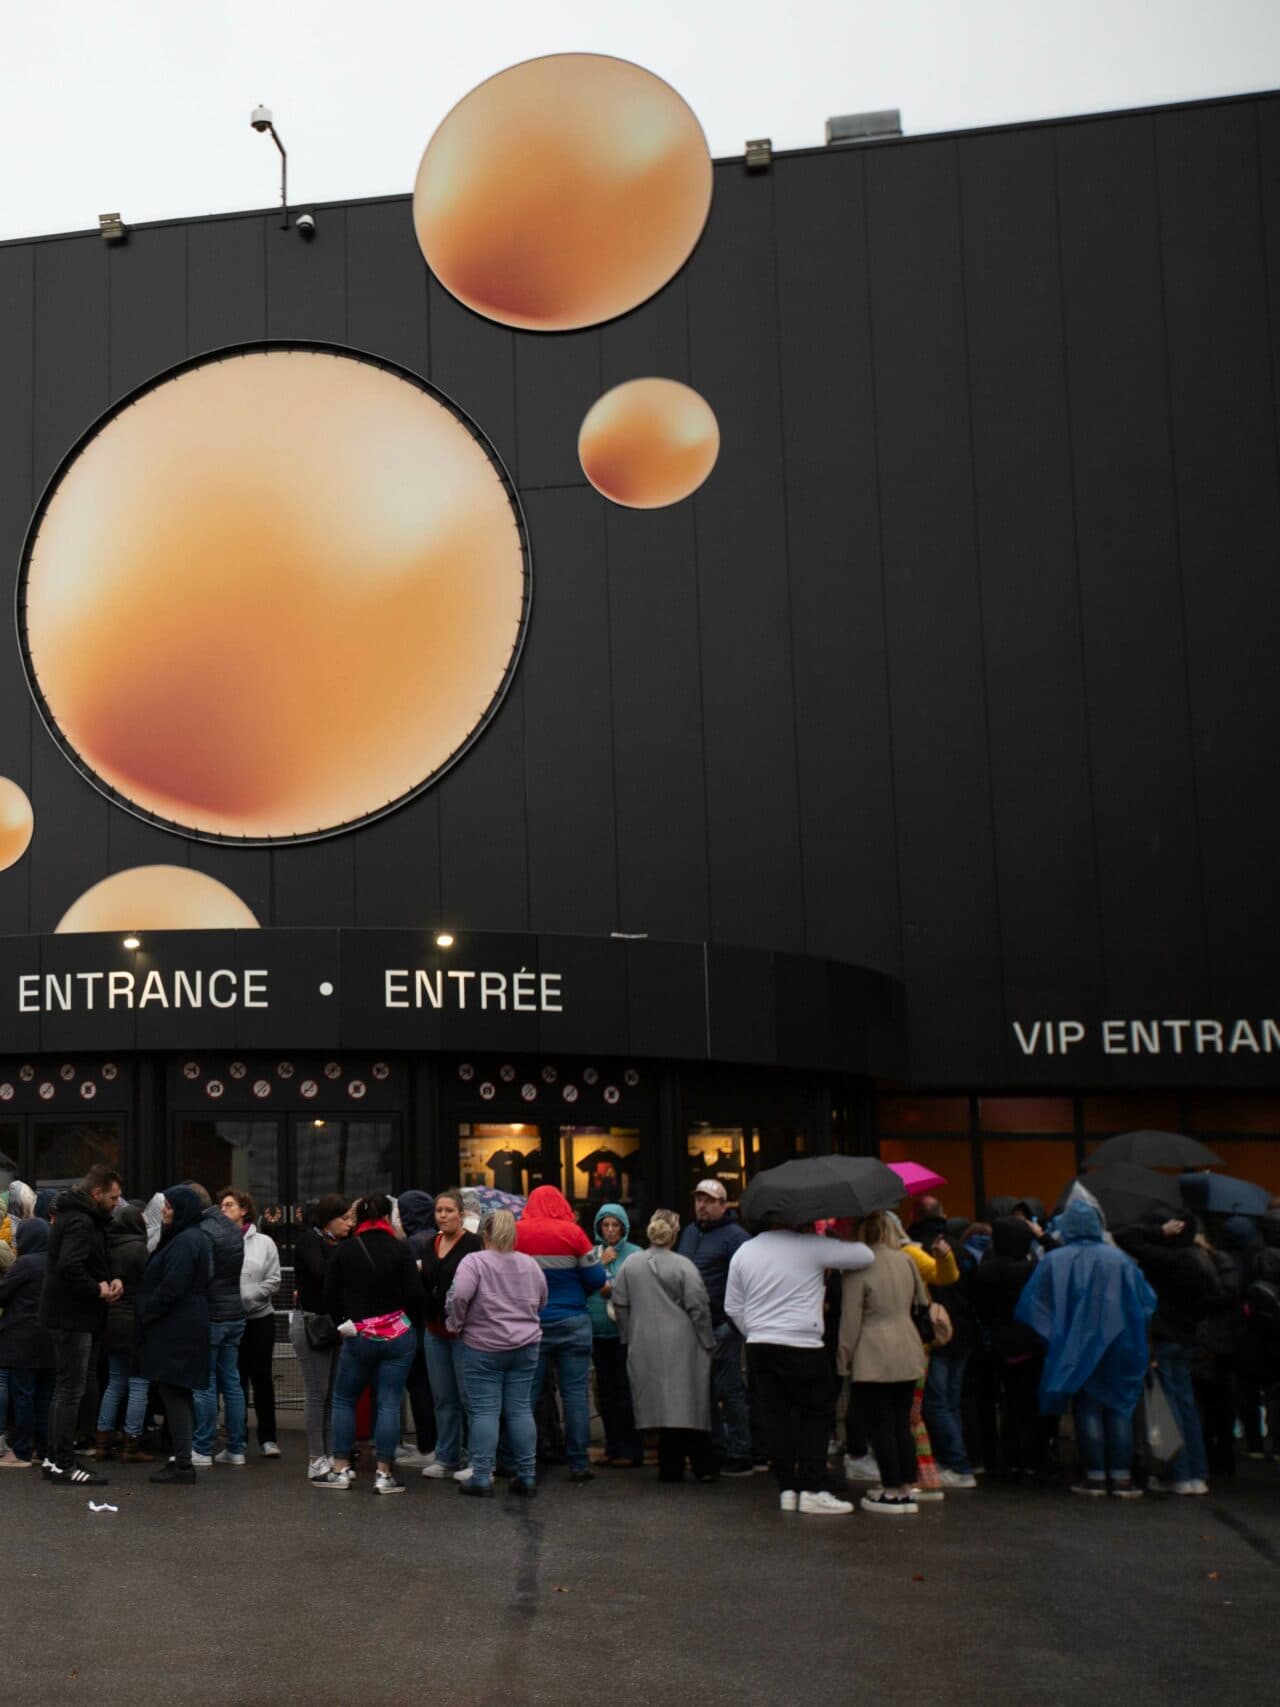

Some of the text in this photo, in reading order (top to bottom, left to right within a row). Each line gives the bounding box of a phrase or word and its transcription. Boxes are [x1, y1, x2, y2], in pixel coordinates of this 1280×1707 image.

[18, 969, 269, 1013] ENTRANCE
[384, 967, 563, 1012] ENTRÉE
[1012, 1019, 1280, 1055] VIP ENTRAN
